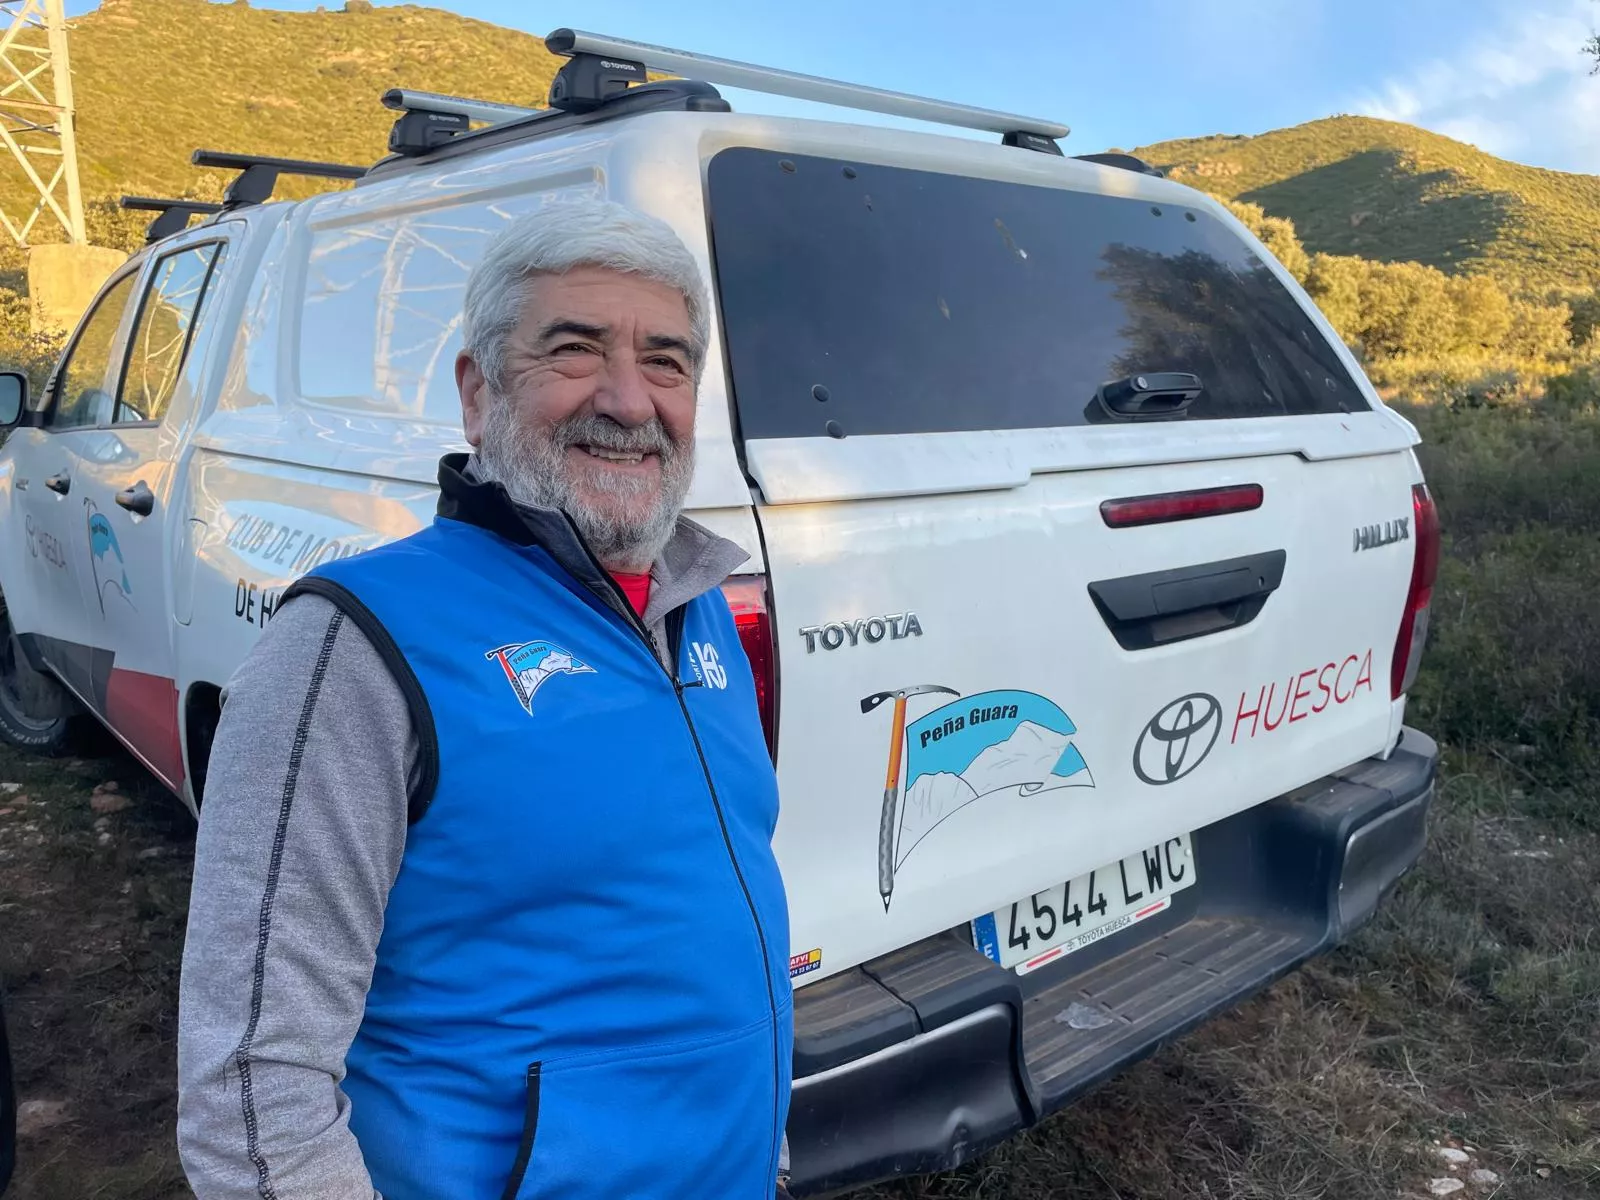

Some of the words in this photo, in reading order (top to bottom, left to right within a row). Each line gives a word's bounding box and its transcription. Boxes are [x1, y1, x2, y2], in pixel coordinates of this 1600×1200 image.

[225, 513, 275, 555] CLUB
[262, 526, 303, 565] DE
[1352, 516, 1409, 553] HILUX
[235, 577, 258, 624] DE
[799, 611, 924, 654] TOYOTA
[1230, 648, 1373, 744] HUESCA
[919, 716, 965, 749] Peña
[969, 704, 1019, 726] Guara
[1008, 870, 1108, 950] 4544
[1119, 837, 1185, 905] LWC
[1078, 927, 1105, 946] TOYOTA
[1105, 915, 1132, 934] HUESCA
